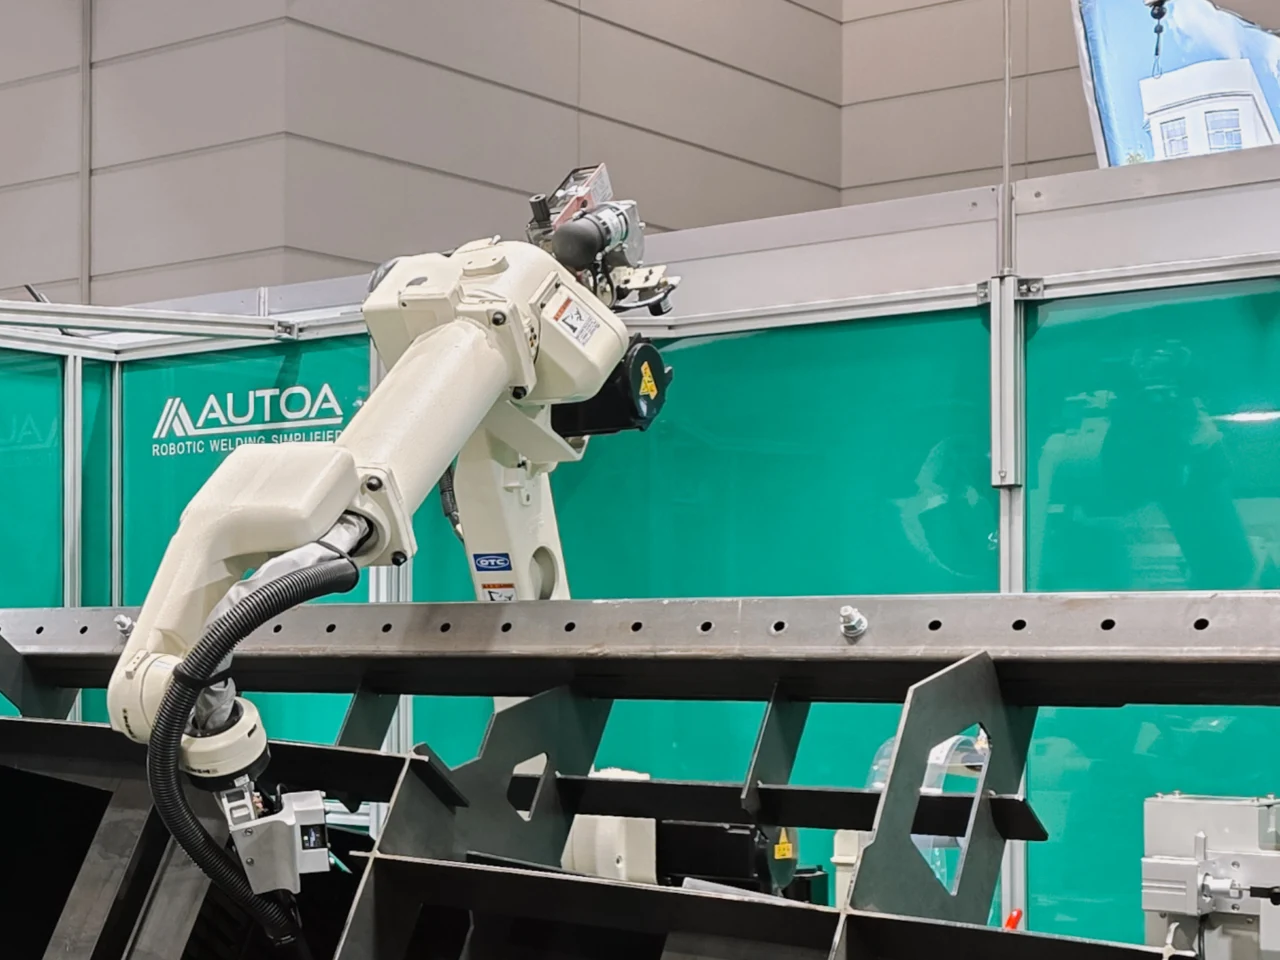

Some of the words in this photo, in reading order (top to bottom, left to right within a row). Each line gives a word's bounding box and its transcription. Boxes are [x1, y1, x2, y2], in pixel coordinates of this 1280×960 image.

[195, 383, 344, 427] AUTOA
[152, 441, 205, 457] ROBOTIC
[209, 435, 266, 453] WELDING
